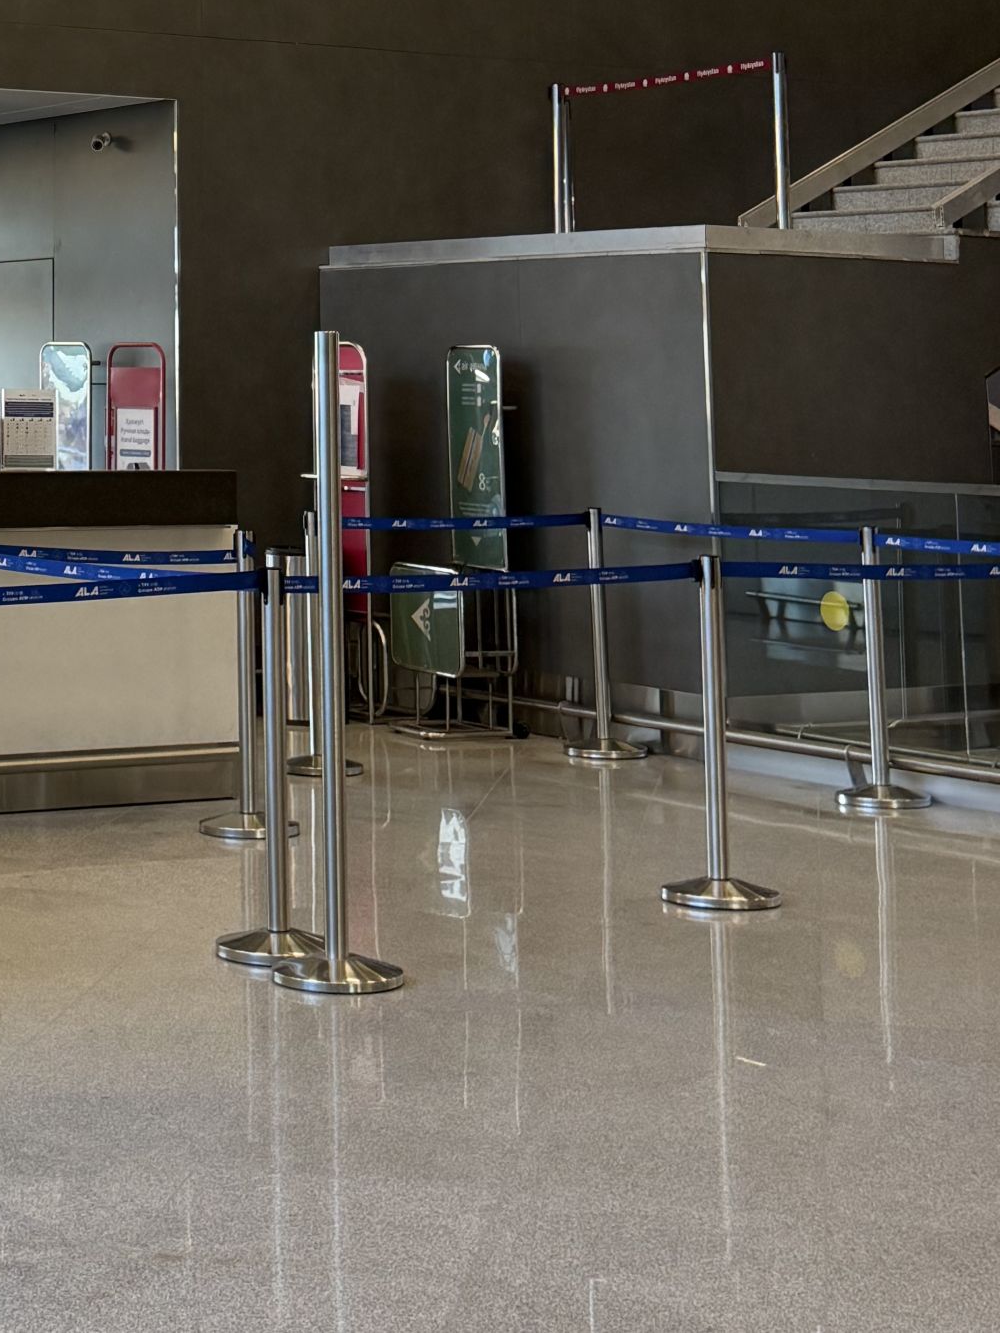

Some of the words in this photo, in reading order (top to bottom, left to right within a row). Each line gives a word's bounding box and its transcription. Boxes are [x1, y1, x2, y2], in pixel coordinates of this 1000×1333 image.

[19, 549, 37, 558] ALA
[122, 553, 141, 562] ALA
[779, 566, 798, 575] ALA
[886, 568, 905, 577] ALA
[449, 577, 469, 587] ALA
[552, 573, 571, 583] ALA
[342, 579, 361, 589] ALA
[74, 586, 99, 598] ALA
